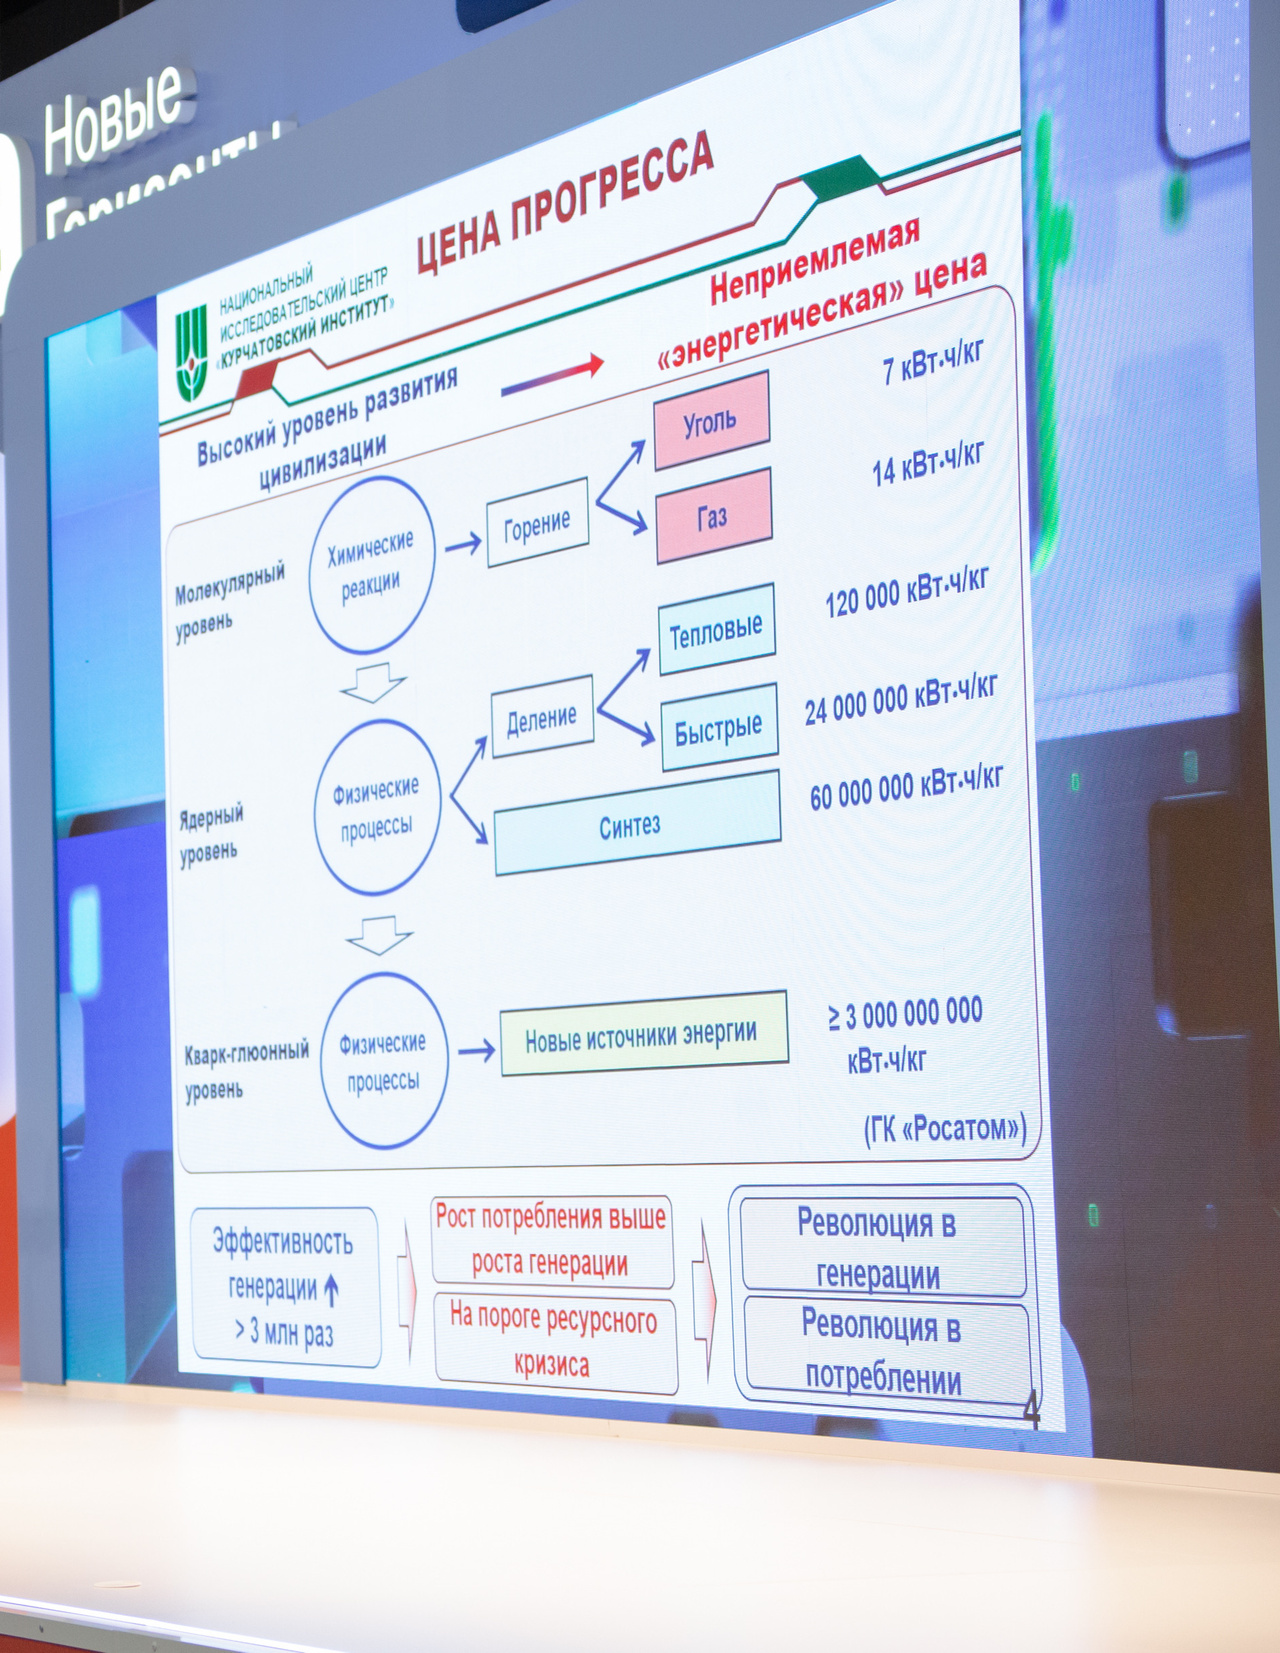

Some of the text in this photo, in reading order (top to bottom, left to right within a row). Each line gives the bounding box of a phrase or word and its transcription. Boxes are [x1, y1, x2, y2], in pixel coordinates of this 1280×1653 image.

[45, 66, 183, 176] Новые
[417, 130, 716, 277] ЦЕНА ПРОГРЕССА
[710, 217, 921, 307] Неприемлемая
[220, 261, 313, 316] НАЦИОНАЛЬНЫЙ
[220, 266, 388, 342] ИССЛЕДОВАТЕЛЬСКИЙ ЦЕНТР
[657, 252, 989, 374] «энергетическая» цена
[883, 357, 894, 386] 7
[198, 366, 458, 468] Высокий уровень развития
[684, 408, 737, 441] Уголь
[260, 434, 387, 493] цивилизации
[873, 460, 896, 487] 14
[504, 508, 570, 546] Горение
[698, 505, 728, 532] Газ
[328, 530, 414, 568] Химические
[175, 559, 285, 606] Молекулярный
[341, 570, 400, 607] реакции
[826, 587, 858, 618] 120
[866, 579, 899, 610] 000
[176, 613, 233, 646] уровень
[670, 613, 763, 651] Тепловые
[507, 705, 577, 740] Деление
[805, 698, 827, 726] 24
[833, 691, 866, 721] 000
[873, 684, 908, 714] 000
[675, 713, 763, 747] Быстрые
[333, 776, 419, 807] Физические
[810, 784, 832, 811] 60
[839, 778, 872, 808] 000
[879, 772, 913, 802] 000
[179, 801, 244, 832] Ядерный
[341, 816, 412, 846] процессы
[600, 813, 661, 841] Синтез
[180, 843, 237, 870] уровень
[846, 1003, 856, 1029] 3
[863, 1000, 897, 1029] 000
[904, 998, 939, 1026] 000
[947, 994, 983, 1024] 000
[185, 1037, 310, 1067] Кварк-глюонный
[340, 1033, 426, 1058] Физические
[526, 1018, 757, 1054] Новые источники энергии
[185, 1079, 243, 1106] уровень
[348, 1071, 420, 1098] процессы
[864, 1110, 1027, 1150] (ГК «Росатом»)
[436, 1200, 666, 1235] Рост потребления выше
[798, 1205, 956, 1242] Революция в
[213, 1226, 354, 1259] Эффективность
[472, 1249, 628, 1281] роста генерации
[817, 1262, 940, 1295] генерации
[229, 1272, 317, 1305] генерации
[235, 1317, 334, 1353] > 3 млн раз
[450, 1298, 657, 1337] На пороге ресурсного
[802, 1306, 961, 1346] Революция в
[514, 1351, 590, 1385] кризиса
[806, 1358, 962, 1396] потреблении
[1023, 1389, 1041, 1431] 4
